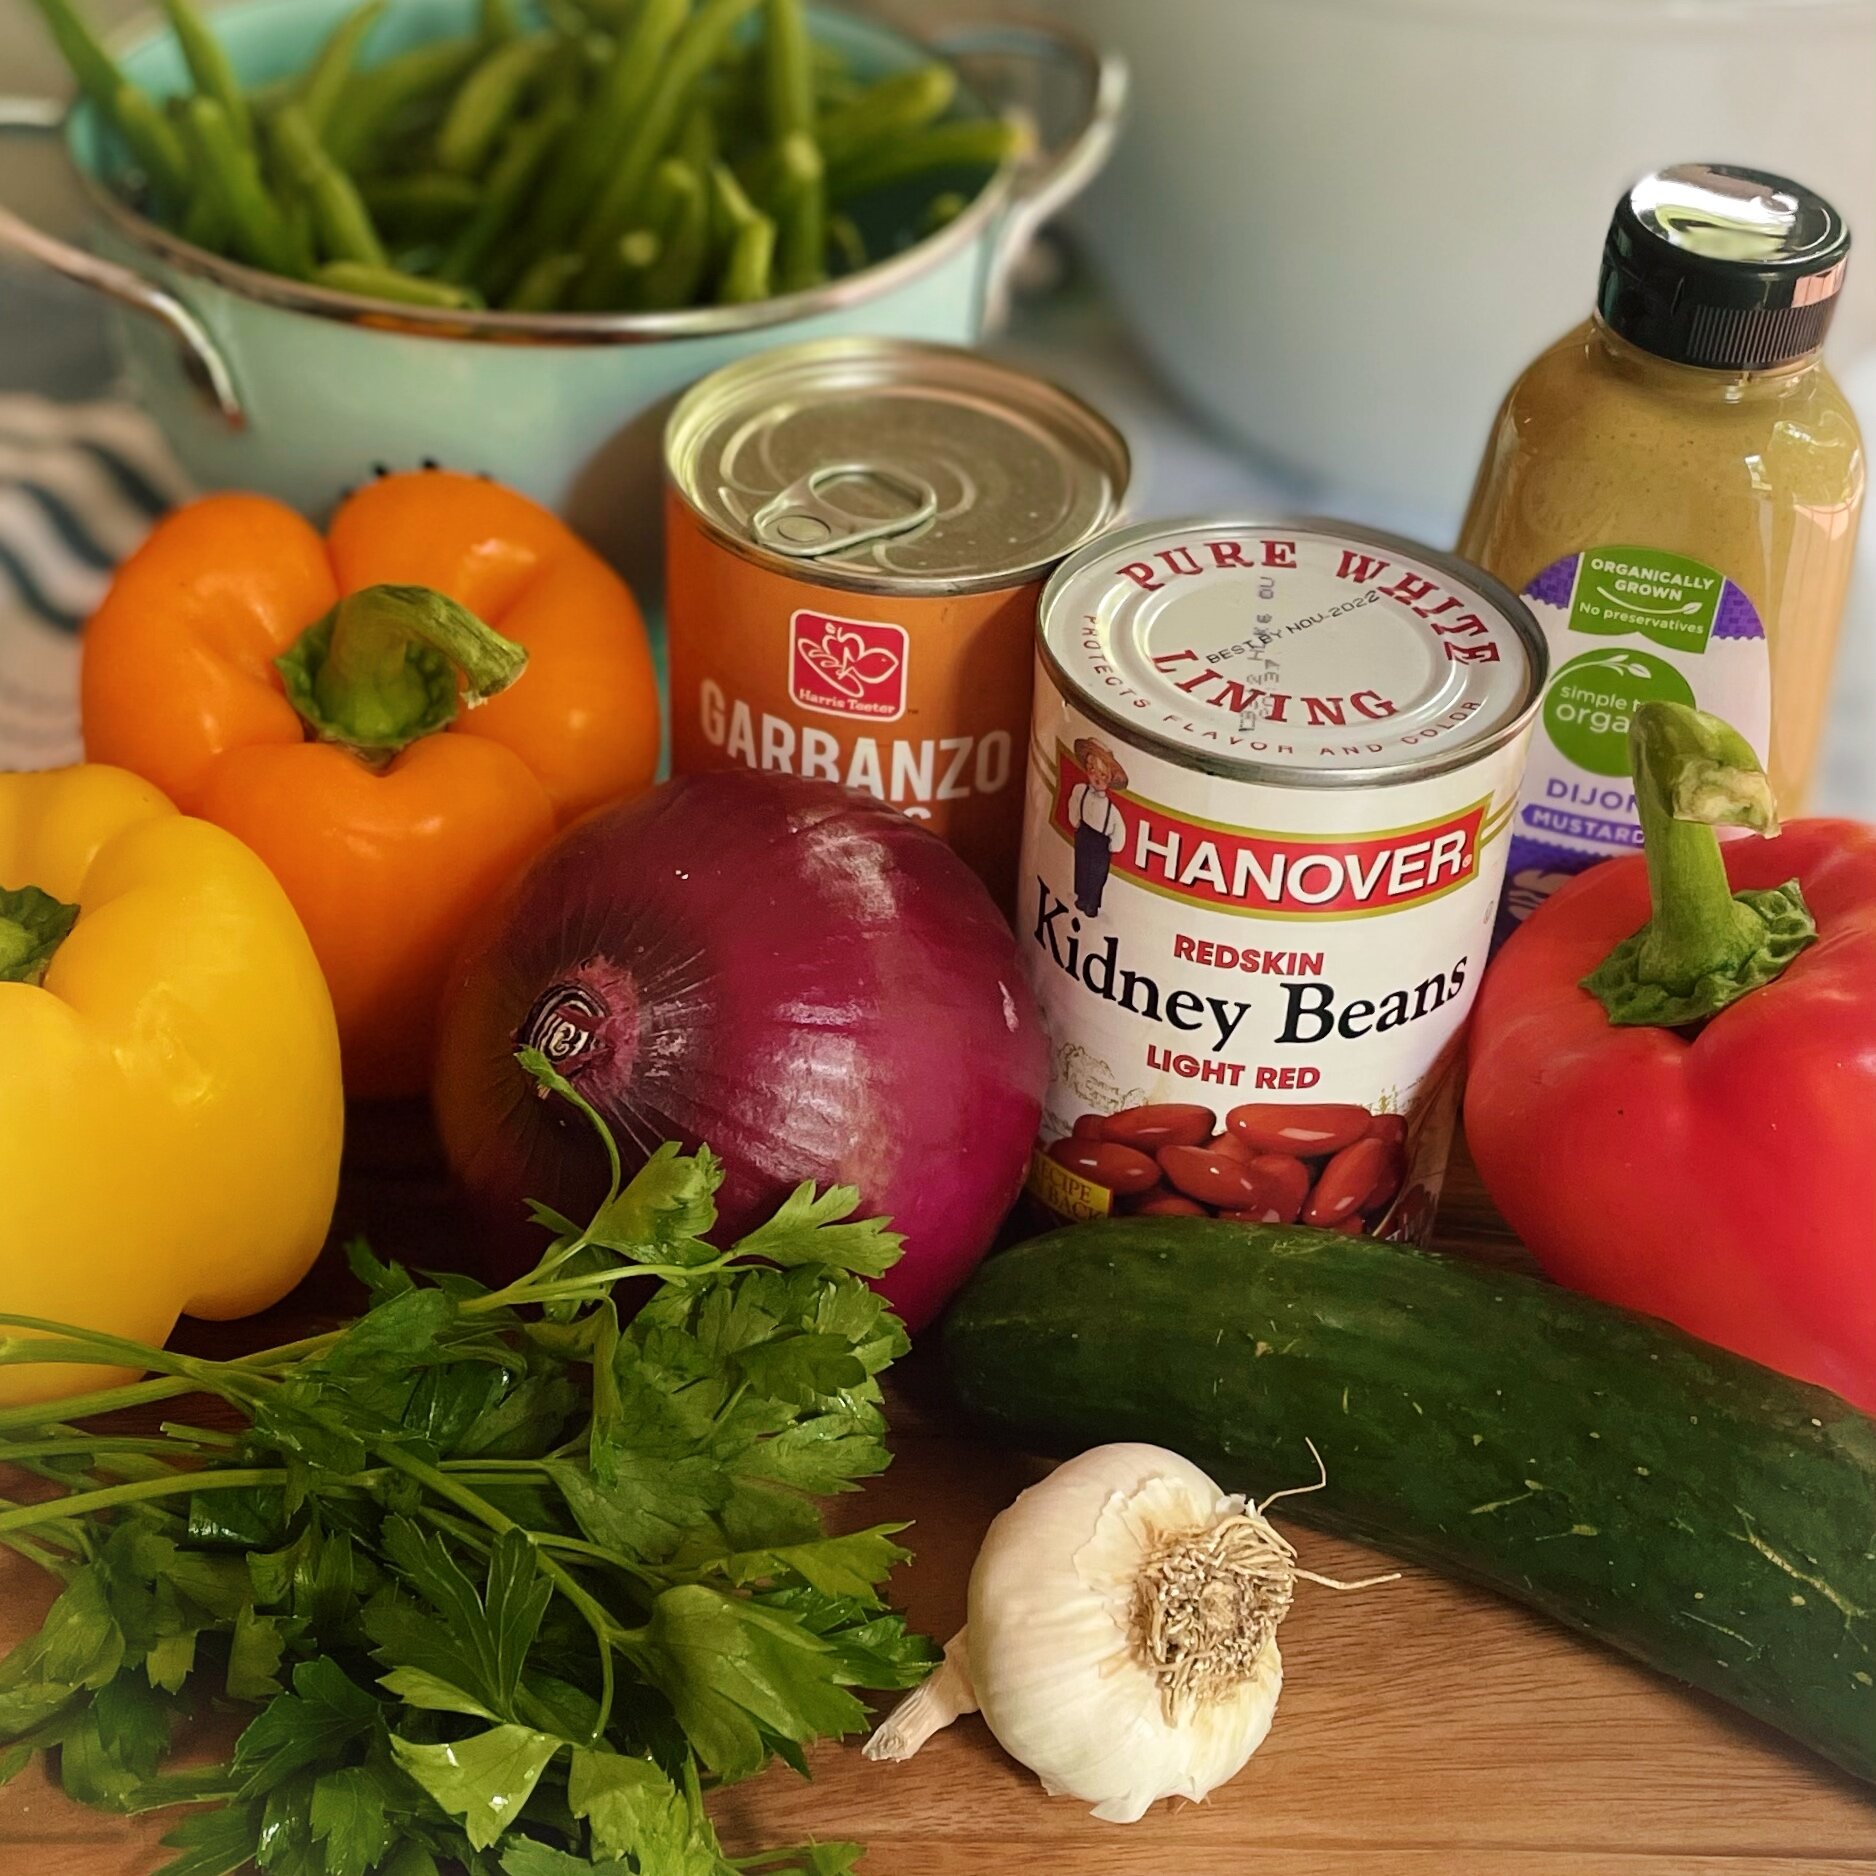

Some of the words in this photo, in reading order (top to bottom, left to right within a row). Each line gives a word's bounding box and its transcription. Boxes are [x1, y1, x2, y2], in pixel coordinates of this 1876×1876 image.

[1590, 558, 1714, 590] ORGANICALLY
[1614, 579, 1683, 601] GROWN
[1115, 540, 1298, 592] PURE
[1335, 549, 1501, 666] WHITE
[1578, 601, 1601, 616] No
[1603, 608, 1704, 634] preservatives
[1206, 639, 1257, 665] BEST
[1258, 624, 1284, 645] BY
[799, 687, 846, 708] Harris
[1081, 614, 1151, 709] PROTECTS
[1162, 714, 1294, 754] FLAVOR
[1319, 743, 1384, 757] AND
[1400, 701, 1482, 746] COLOR
[1152, 649, 1399, 727] LINING
[1560, 685, 1628, 711] simple
[701, 678, 1012, 801] GARBANZO
[1556, 703, 1632, 734] orga
[1532, 809, 1645, 845] MUSTARD
[1134, 818, 1468, 904] HANOVER
[1033, 875, 1252, 1053] Kidney
[1274, 955, 1468, 1045] Beans
[1173, 934, 1325, 977] REDSKIN
[1145, 1044, 1246, 1088] LIGHT
[1255, 1066, 1321, 1090] RED
